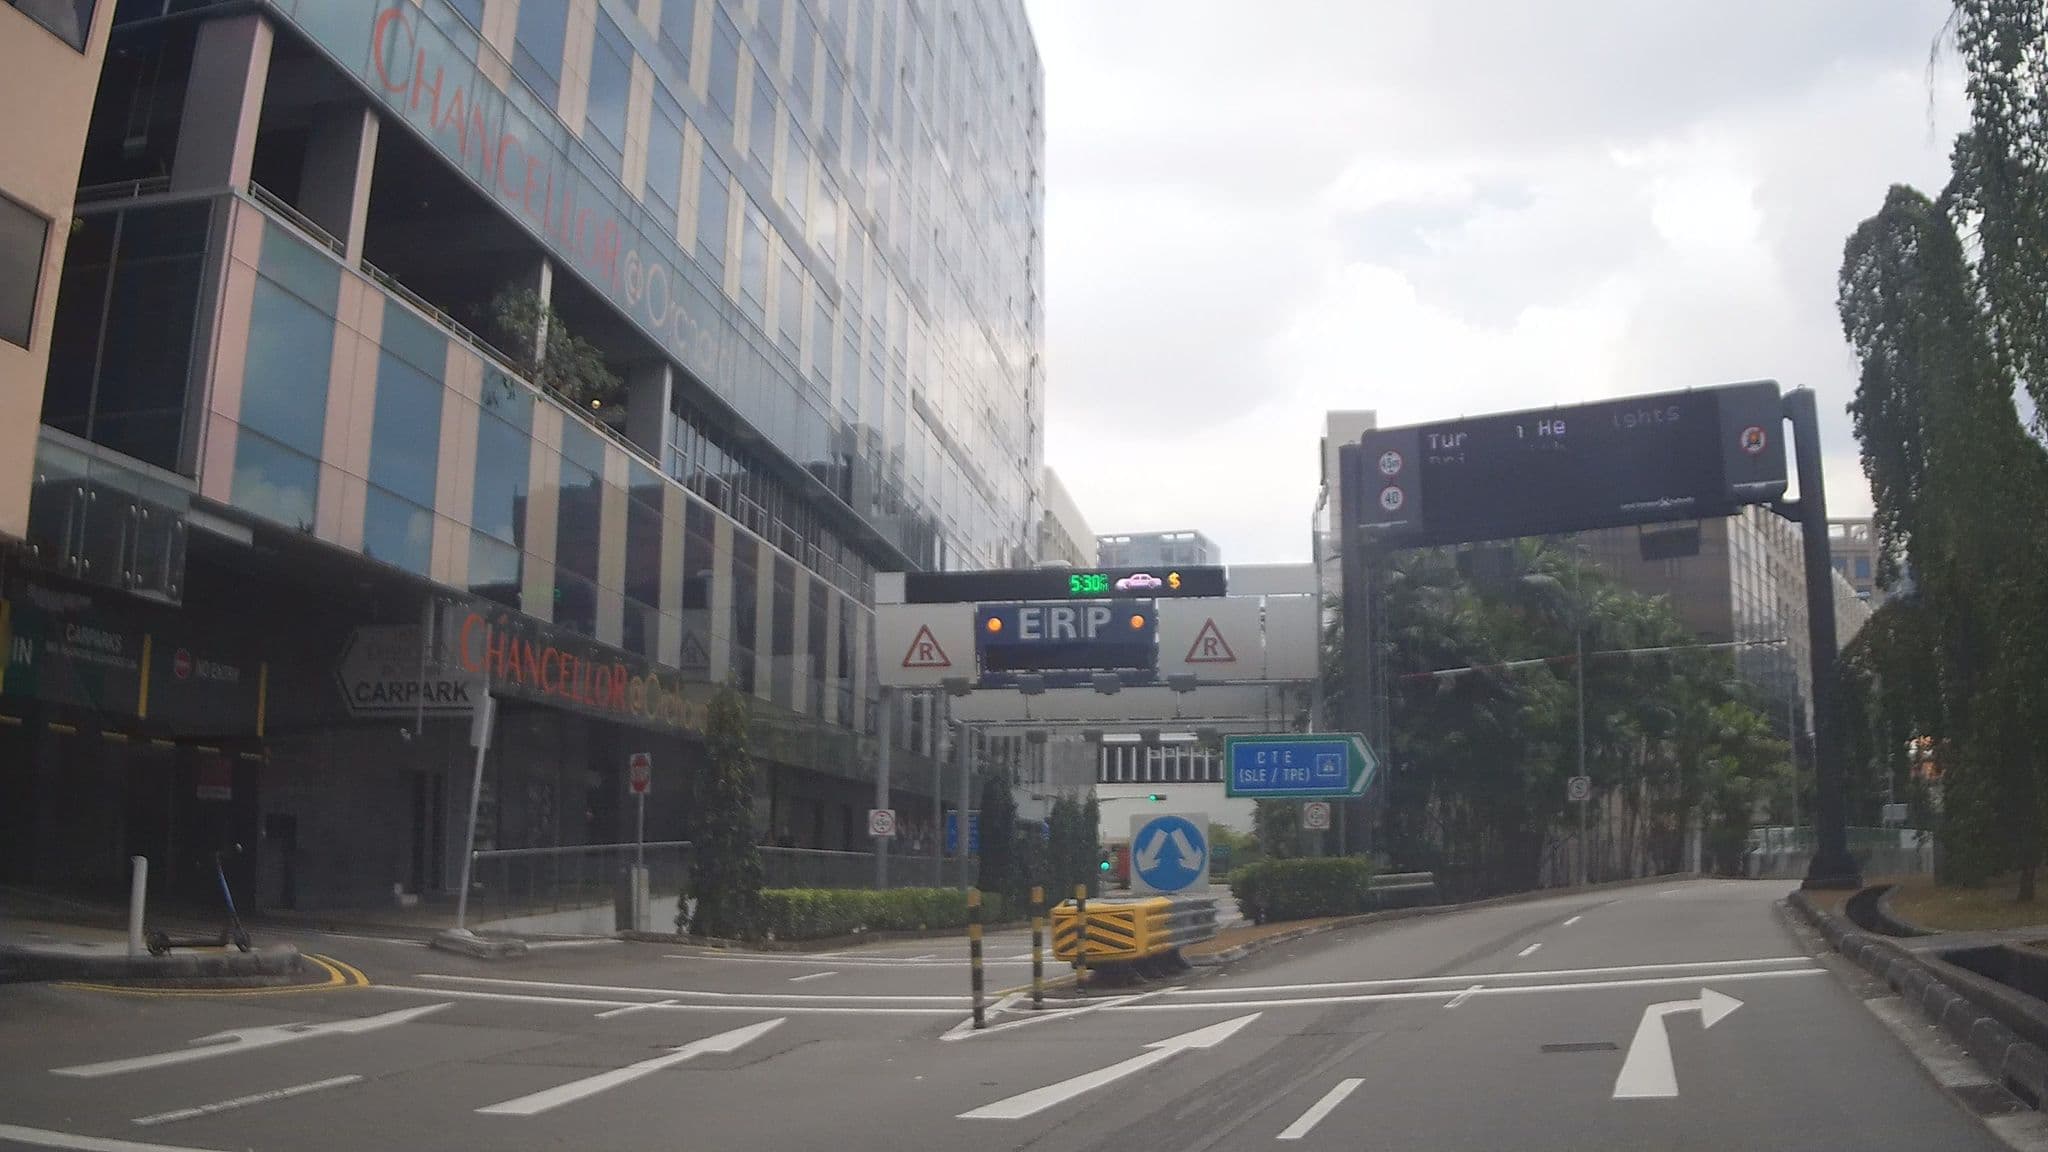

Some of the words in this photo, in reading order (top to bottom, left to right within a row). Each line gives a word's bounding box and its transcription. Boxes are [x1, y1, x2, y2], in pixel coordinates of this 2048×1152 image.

[1018, 606, 1112, 641] ERP
[12, 635, 33, 665] IN
[918, 641, 934, 661] R
[1202, 636, 1218, 657] R
[354, 680, 471, 703] CARPARK
[1256, 750, 1293, 764] CTE
[1238, 767, 1266, 784] (SLE
[1283, 766, 1311, 783] TPE)
